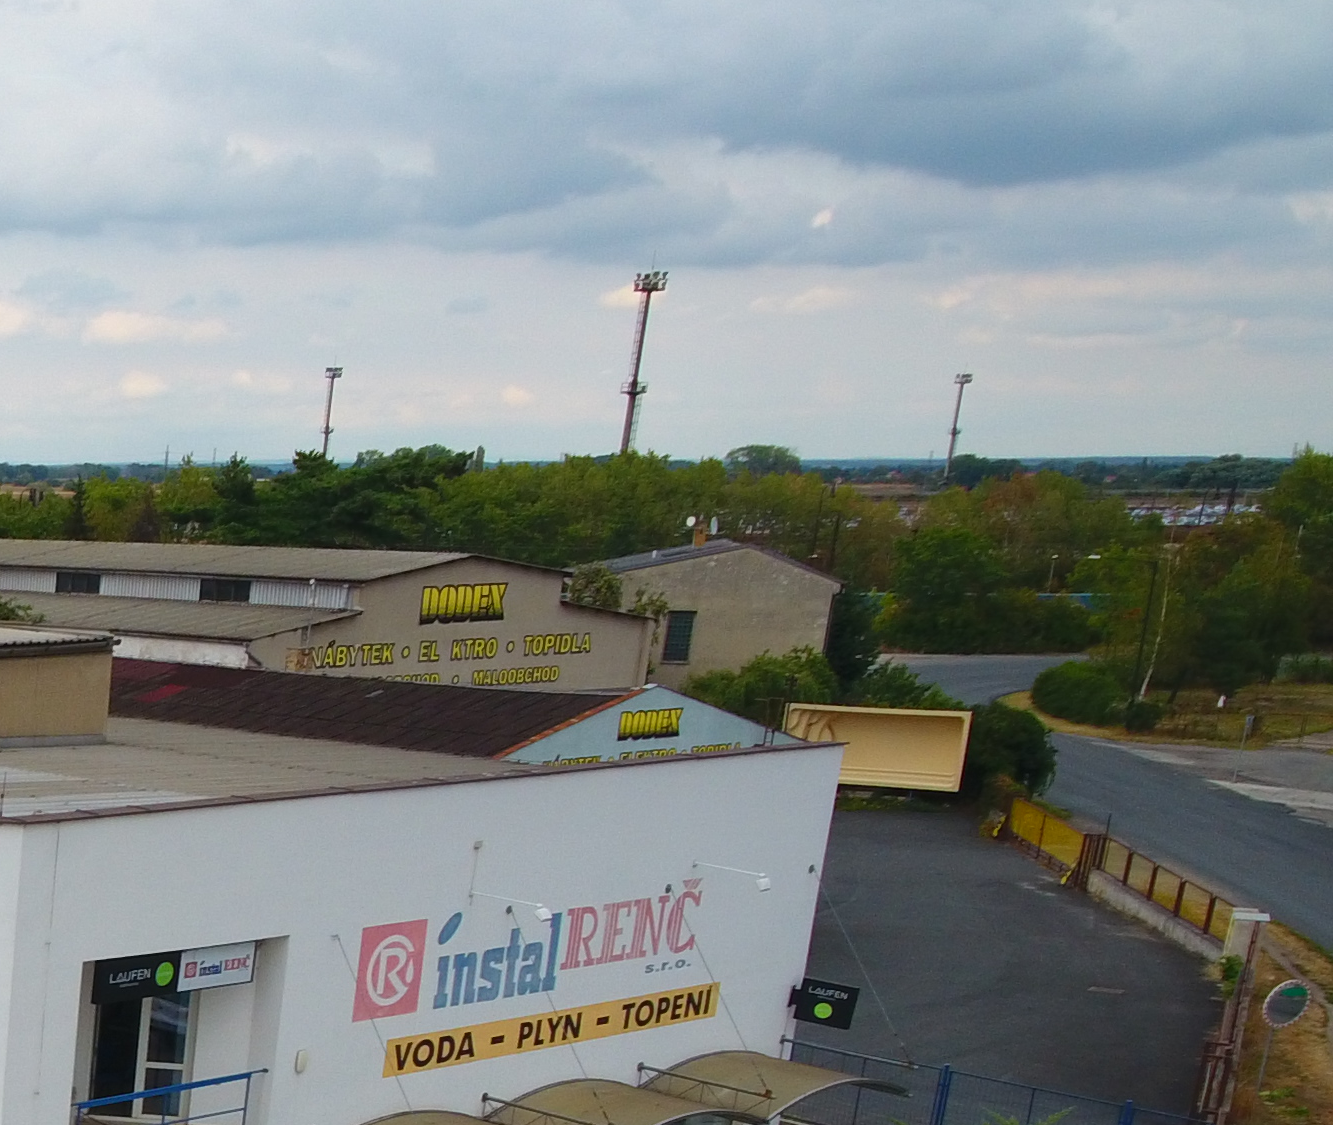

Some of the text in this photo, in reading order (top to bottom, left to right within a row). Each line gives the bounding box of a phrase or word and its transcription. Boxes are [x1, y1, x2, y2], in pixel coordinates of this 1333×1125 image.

[419, 583, 509, 625] DODEX
[523, 632, 591, 656] TOPIDLA
[472, 666, 560, 686] MALOOBCHOD
[617, 708, 684, 741] DODEX
[433, 911, 562, 1010] instal
[560, 878, 703, 970] RENČ
[109, 968, 151, 985] LAUFEN
[644, 959, 691, 974] s.r.o.
[808, 986, 849, 1000] LAUFEN
[395, 1032, 475, 1071] VODA
[517, 1012, 583, 1049] PLYN
[622, 985, 713, 1030] TOPENÍ
